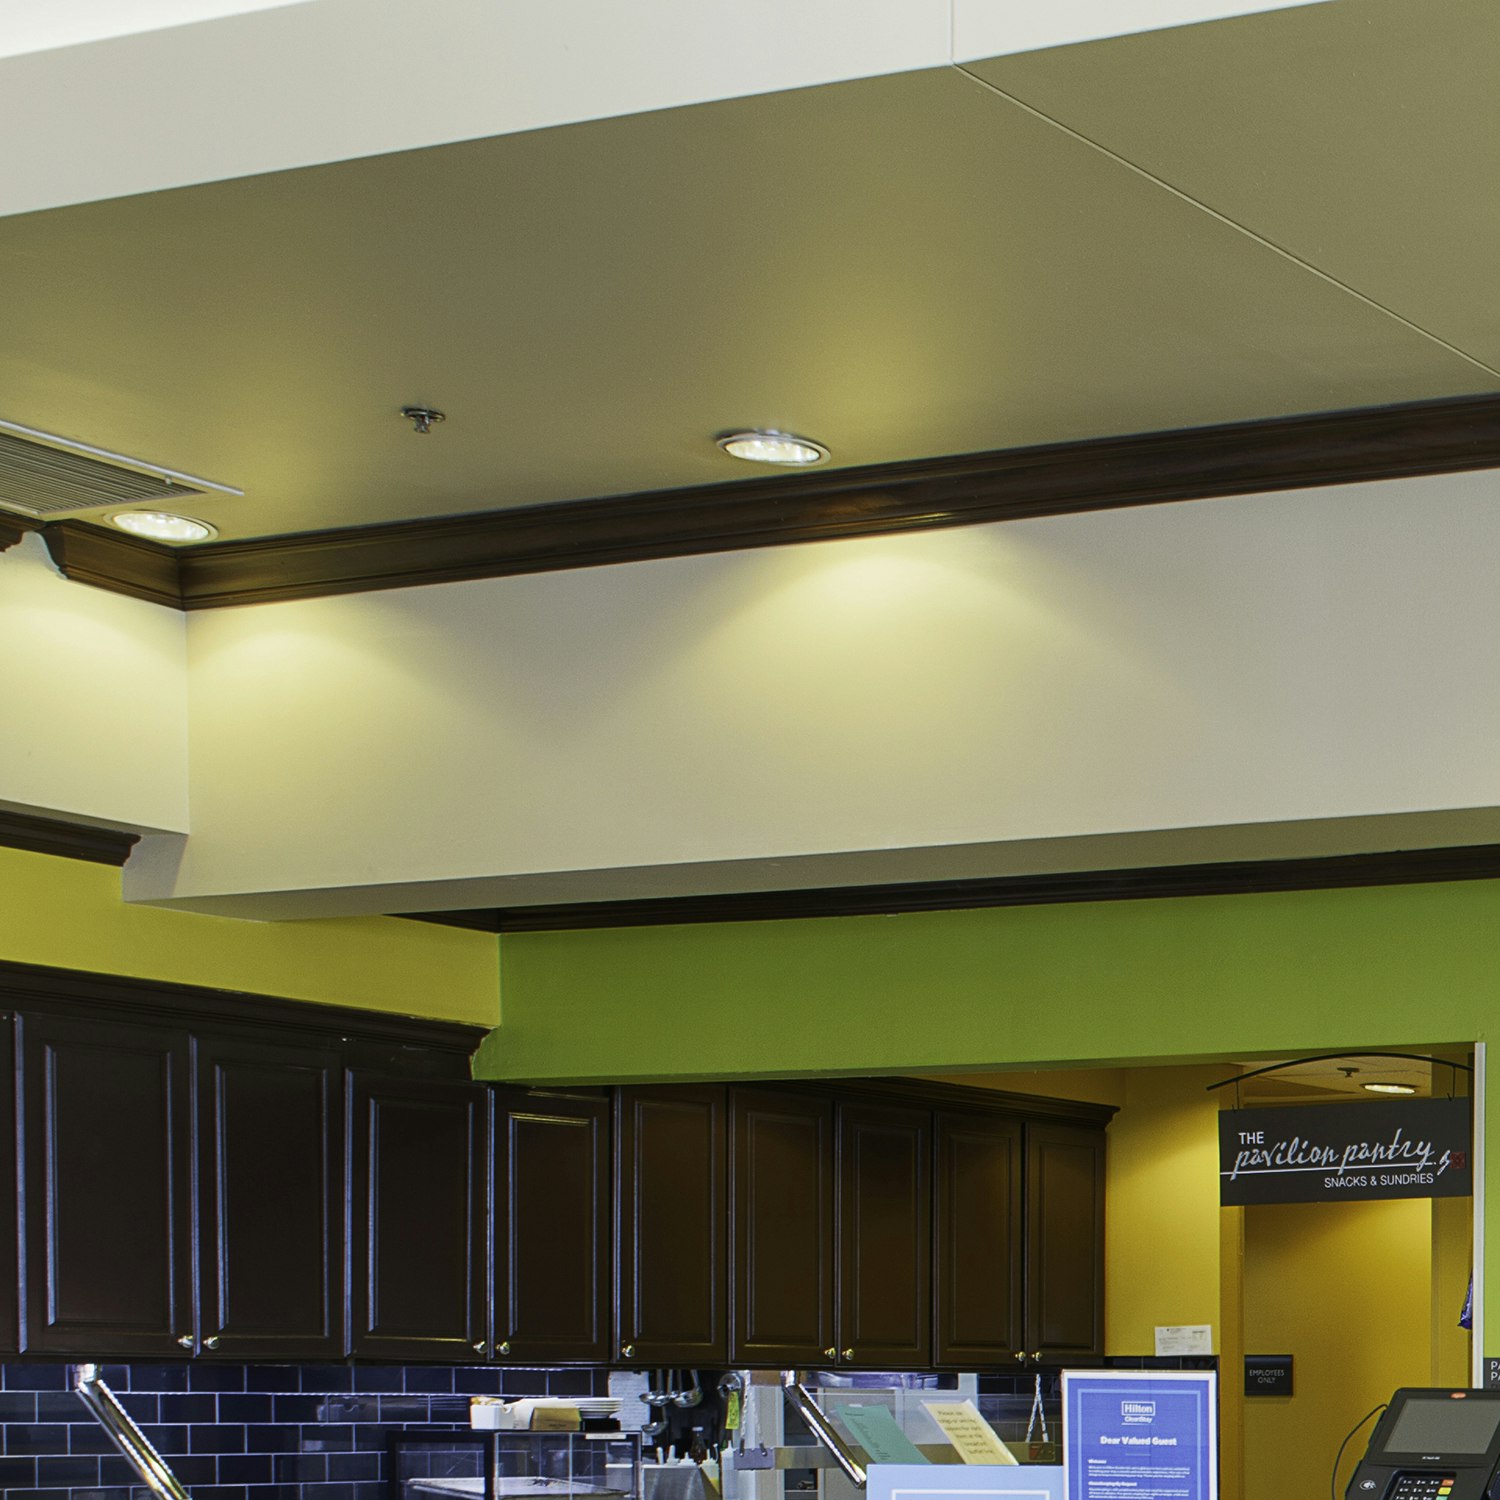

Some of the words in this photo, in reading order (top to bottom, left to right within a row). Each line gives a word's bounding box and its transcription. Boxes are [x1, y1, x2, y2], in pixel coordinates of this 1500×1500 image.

[1239, 1131, 1265, 1145] THE
[1230, 1136, 1339, 1181] pavilion
[1324, 1174, 1368, 1189] SNACKS
[1370, 1174, 1377, 1186] &
[1379, 1173, 1434, 1187] SUNDRIES
[1249, 1369, 1285, 1377] EMPLOYEES
[1257, 1376, 1276, 1384] ONLY
[1124, 1403, 1153, 1414] Hilton
[1100, 1436, 1121, 1446] Dear
[1121, 1436, 1151, 1446] Valued
[1151, 1437, 1177, 1447] Guest
